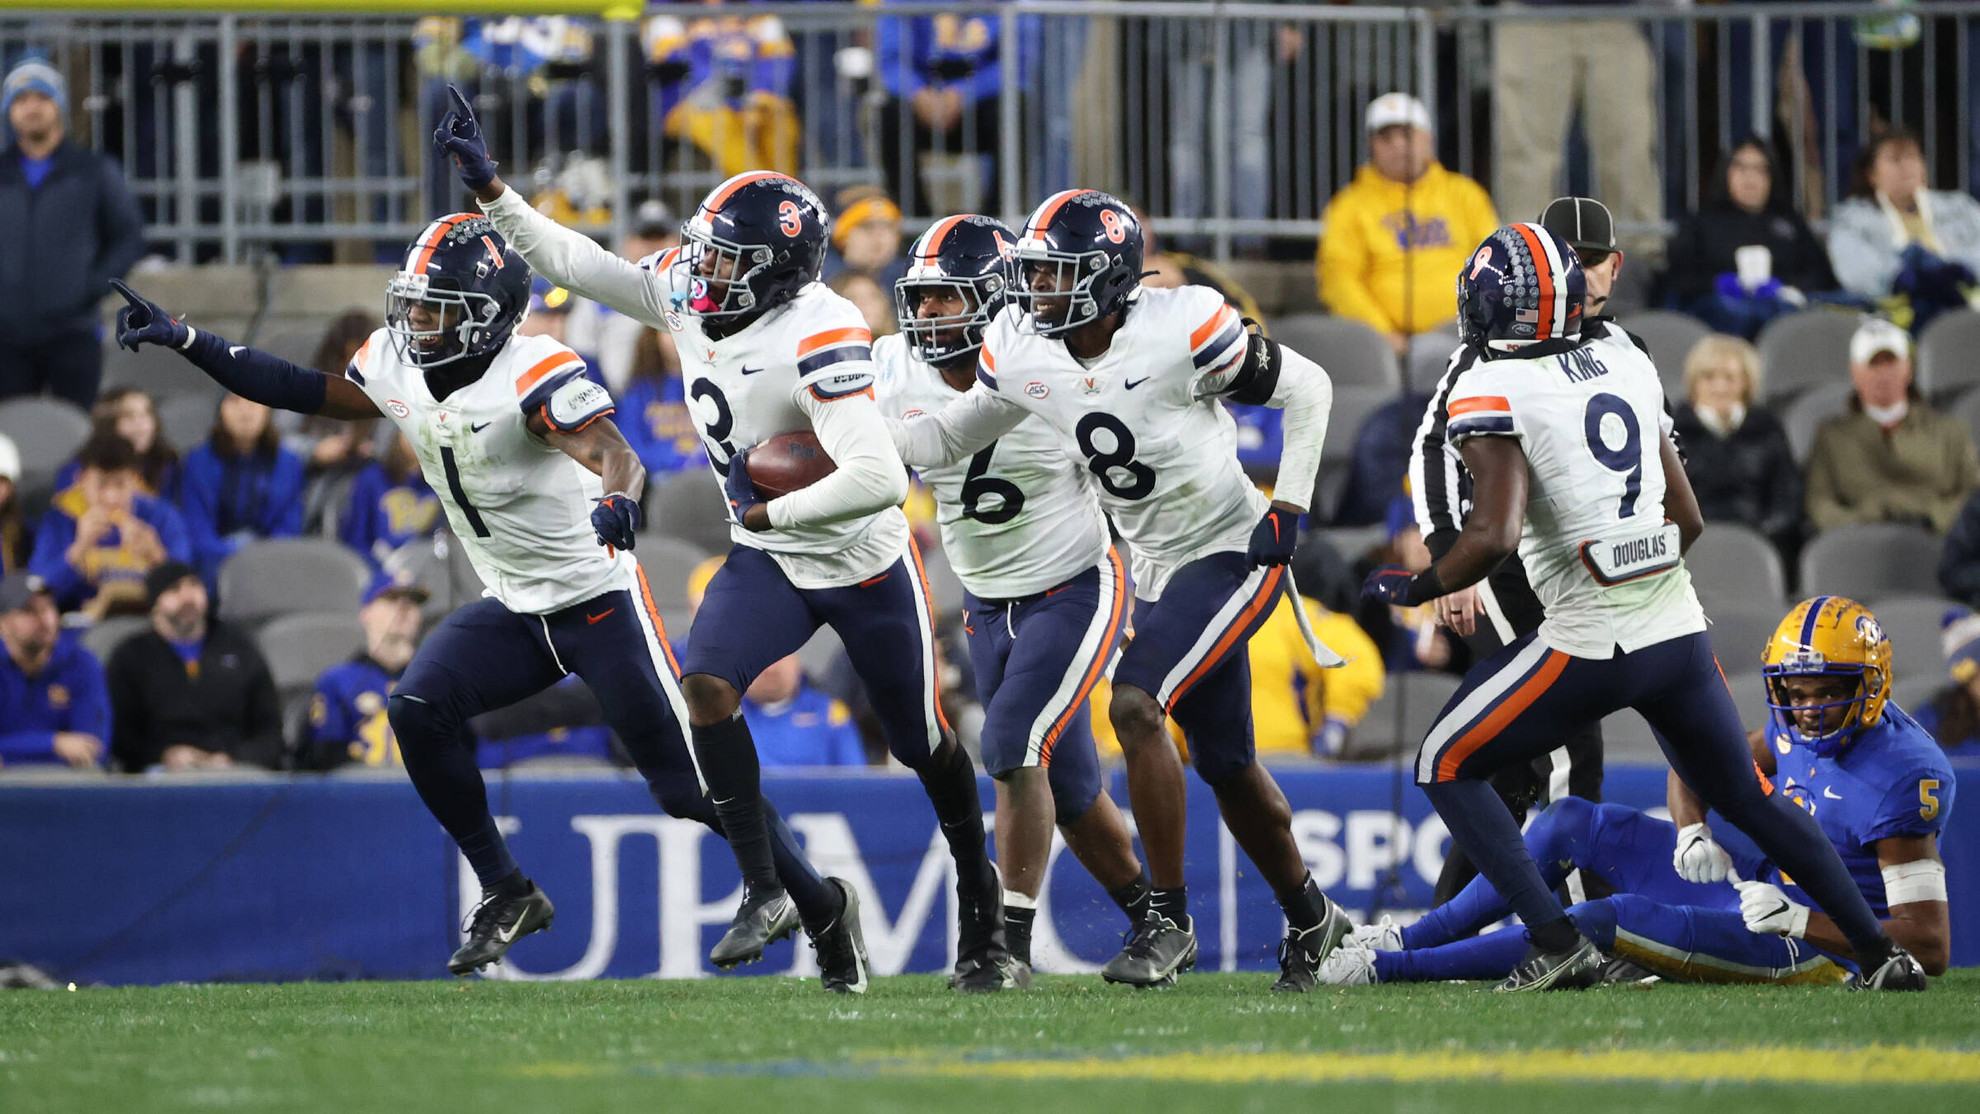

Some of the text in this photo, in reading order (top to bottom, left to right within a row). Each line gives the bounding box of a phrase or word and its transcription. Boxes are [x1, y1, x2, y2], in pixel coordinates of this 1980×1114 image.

[779, 200, 802, 238] 3
[1100, 208, 1126, 244] 8
[480, 236, 504, 269] 1
[1470, 246, 1493, 280] 9
[1557, 347, 1609, 384] KING
[691, 377, 737, 478] 3
[1075, 411, 1156, 500] 8
[1585, 392, 1642, 520] 9
[439, 445, 491, 538] 1
[960, 438, 1025, 524] 6
[1612, 534, 1667, 568] DOUGLAS
[1919, 779, 1940, 821] 5
